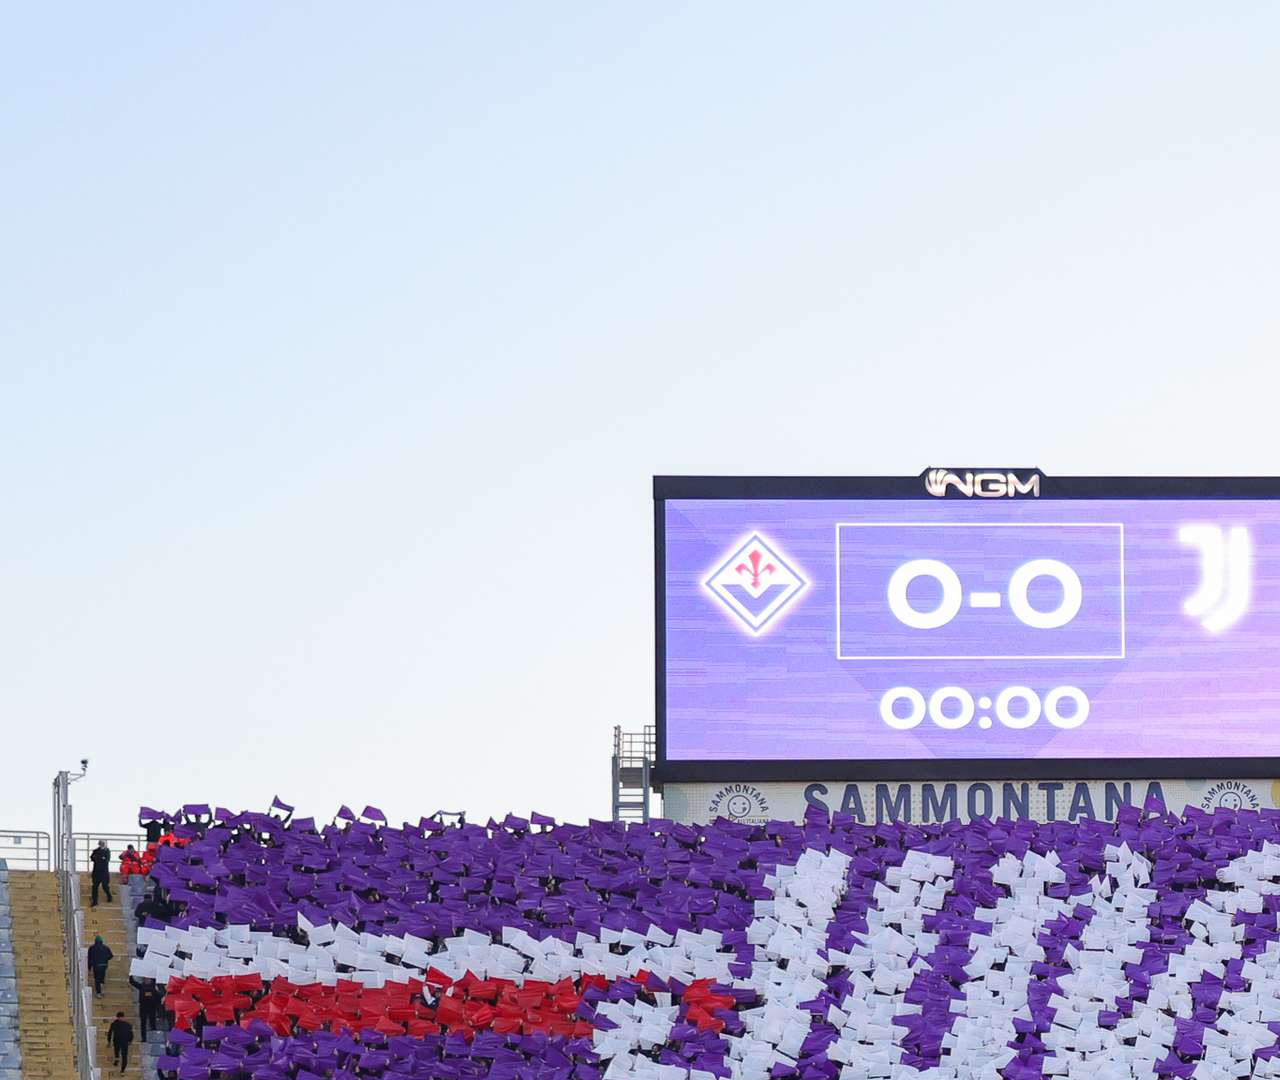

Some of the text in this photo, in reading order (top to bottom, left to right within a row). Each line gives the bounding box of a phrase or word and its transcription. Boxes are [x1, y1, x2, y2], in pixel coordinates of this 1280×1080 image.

[935, 470, 1040, 497] NGM
[887, 558, 1083, 629] 0-0
[880, 686, 1090, 729] 00:00
[709, 783, 769, 813] SAMMONTANA
[804, 782, 1169, 823] SAMMONTANA
[1201, 780, 1260, 809] SAMMONTANA
